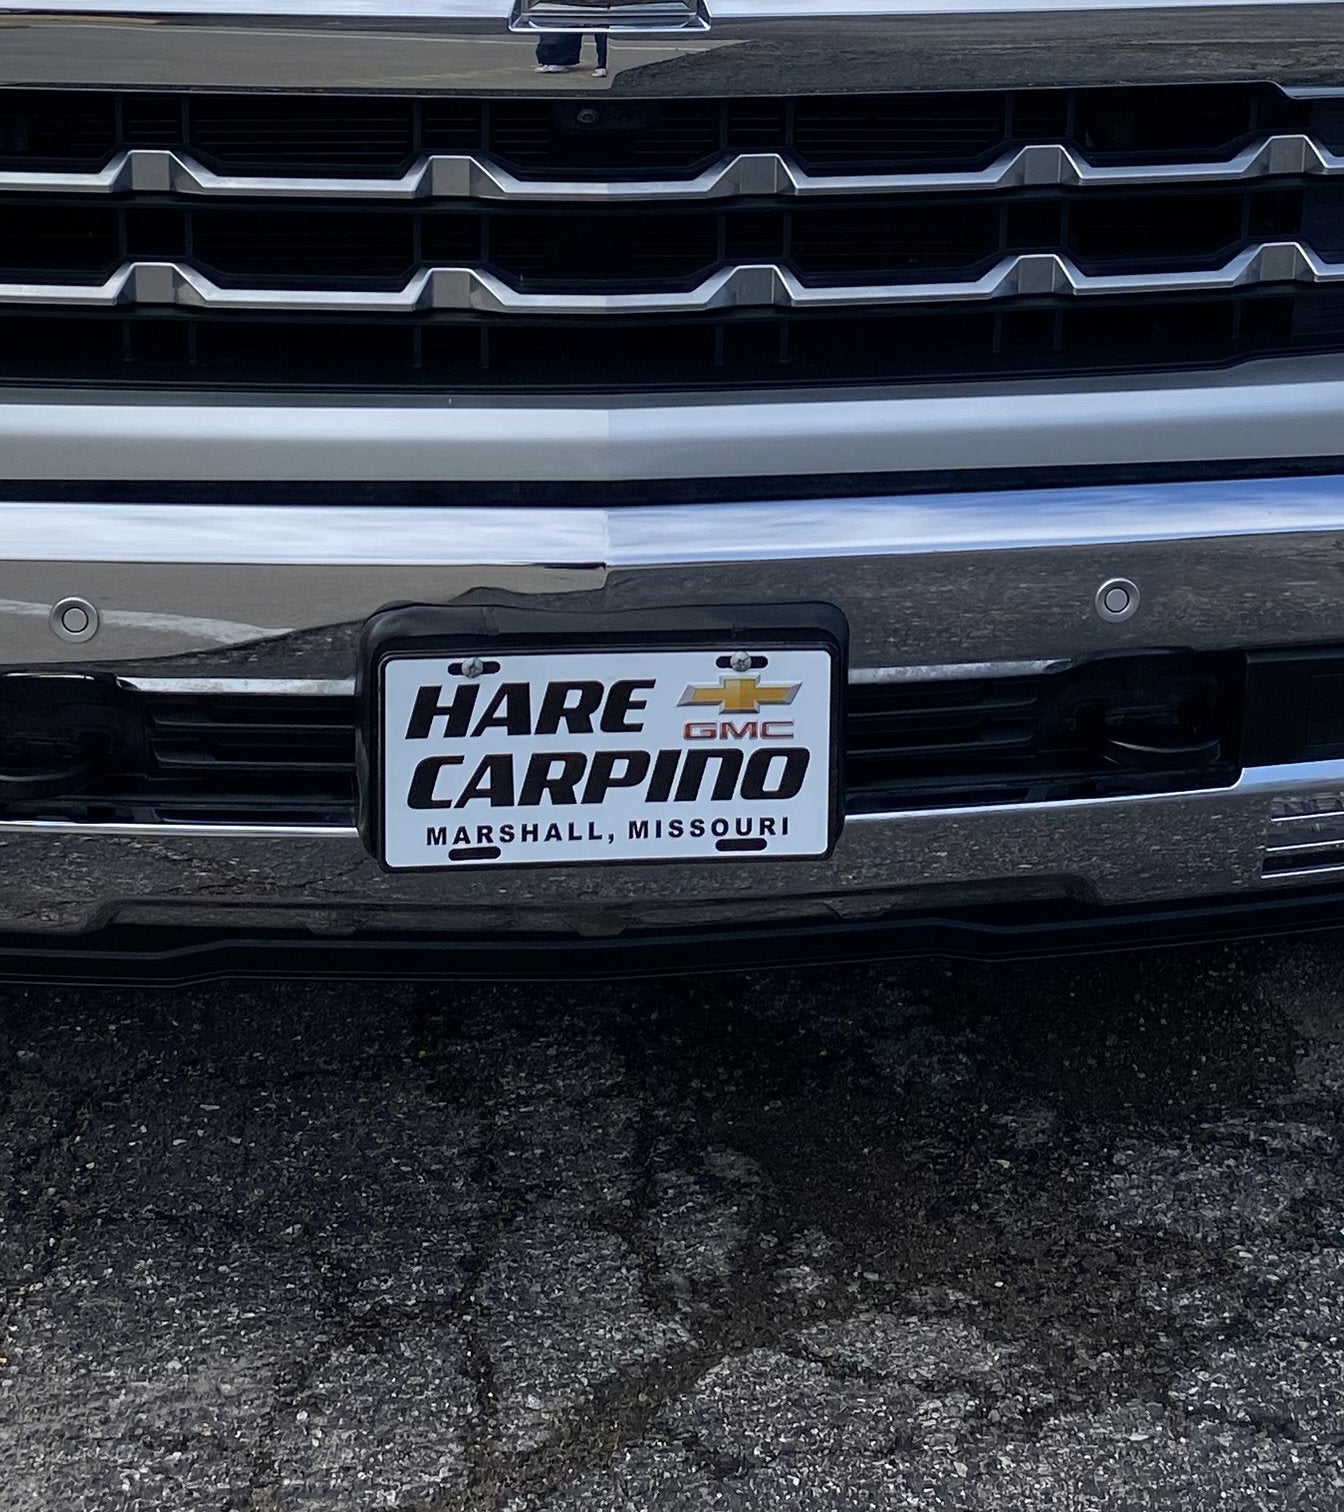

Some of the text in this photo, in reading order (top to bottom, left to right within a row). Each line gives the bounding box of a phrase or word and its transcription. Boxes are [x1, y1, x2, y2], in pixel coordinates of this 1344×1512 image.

[405, 678, 656, 739] HARE
[682, 719, 795, 741] GMC
[406, 747, 810, 810] CARPINO
[425, 816, 789, 846] MARSHALL, MISSOURI
